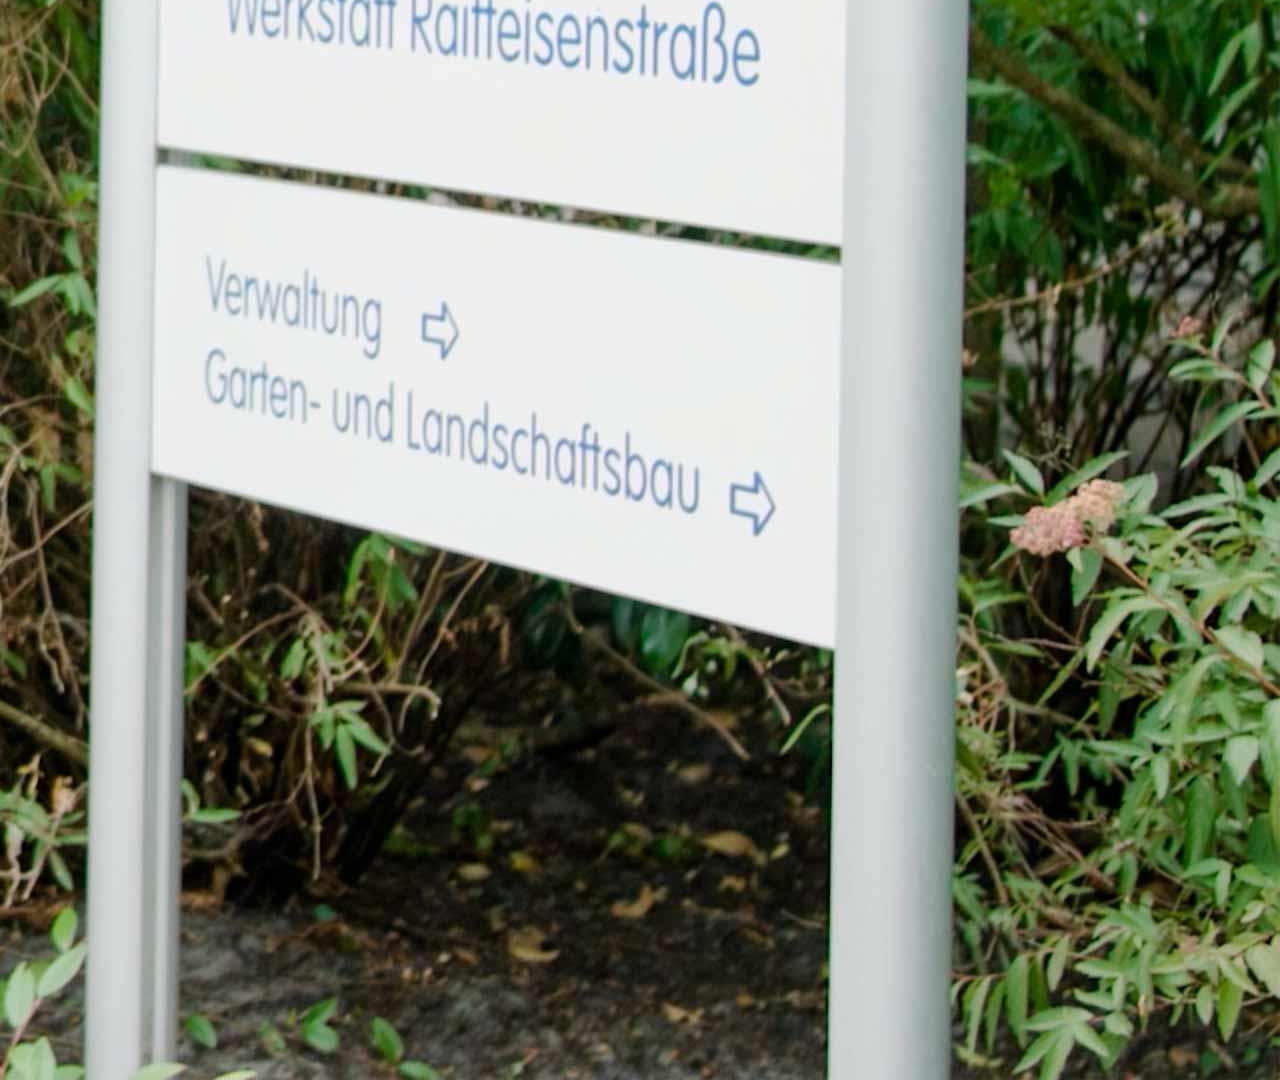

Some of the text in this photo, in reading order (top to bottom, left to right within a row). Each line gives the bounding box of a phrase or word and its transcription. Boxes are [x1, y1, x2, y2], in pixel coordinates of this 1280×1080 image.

[204, 255, 383, 360] Verwaltung
[203, 347, 701, 515] Garten- und Landschaftsbau
